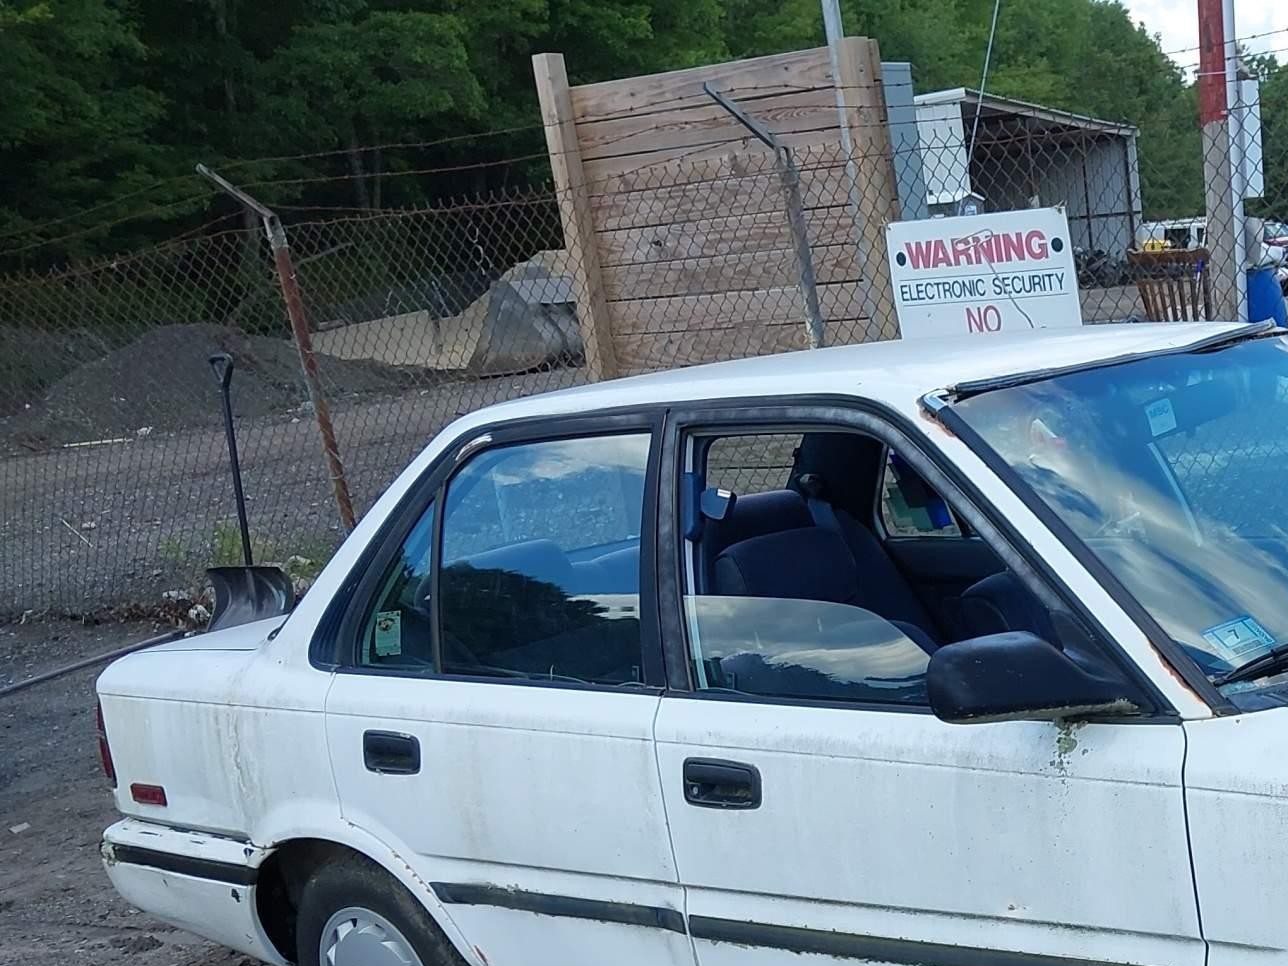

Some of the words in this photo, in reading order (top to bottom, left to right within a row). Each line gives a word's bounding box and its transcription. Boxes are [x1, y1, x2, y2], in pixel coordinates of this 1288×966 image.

[904, 230, 1049, 270] WARNING
[900, 278, 986, 302] ELECTRONIC
[992, 272, 1065, 296] SECURITY
[965, 305, 1002, 333] NO
